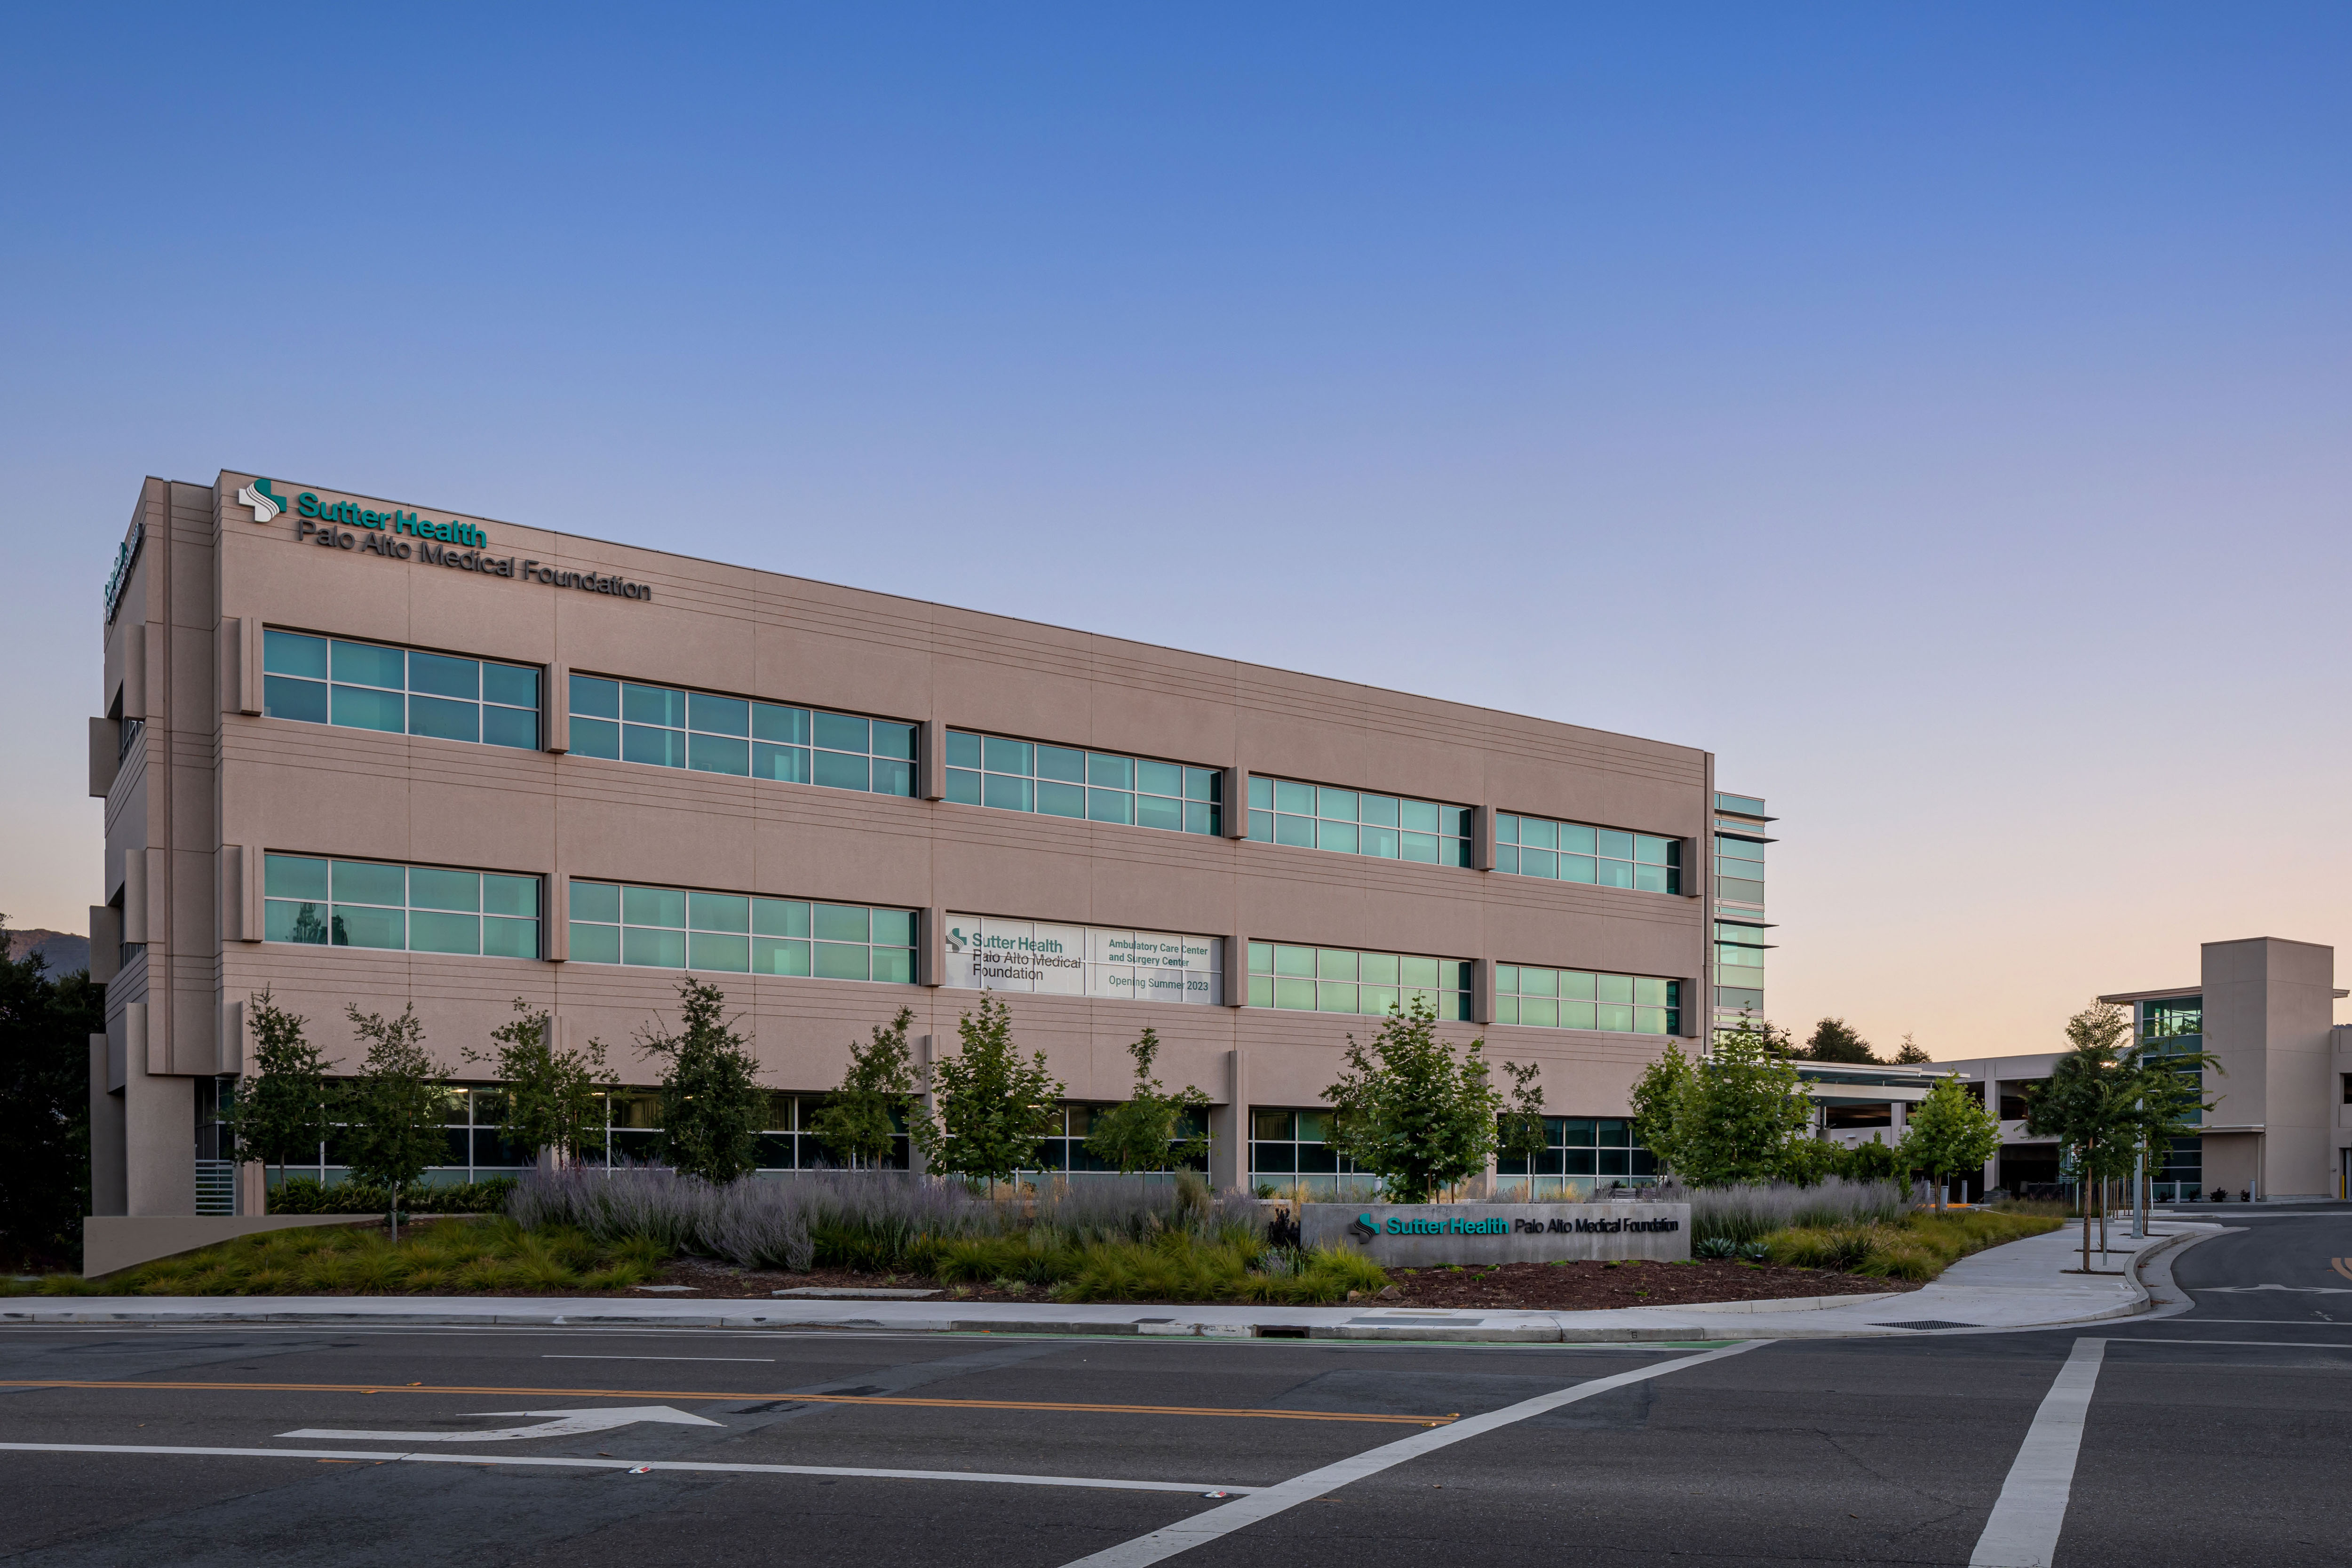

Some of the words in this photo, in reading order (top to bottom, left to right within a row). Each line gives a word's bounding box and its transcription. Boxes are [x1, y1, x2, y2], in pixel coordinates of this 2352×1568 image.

[298, 492, 391, 530] Sutter
[396, 509, 487, 548] Health
[299, 518, 356, 549] Palo
[362, 531, 412, 559] Alto
[421, 541, 515, 578] Medical
[524, 559, 652, 601] Foundation
[972, 933, 1016, 949] Sutter
[1018, 937, 1063, 953] Health
[1109, 939, 1157, 953] Ambulatory
[1160, 944, 1179, 953] Care
[1182, 945, 1208, 955] Center
[973, 948, 1000, 963] Palo
[1004, 951, 1029, 965] Alto
[1033, 954, 1081, 969] Medical
[1109, 953, 1124, 962] and
[1127, 954, 1160, 966] Surgery
[1162, 956, 1189, 967] Center
[973, 963, 1043, 980] Foundation
[1109, 975, 1145, 988] Opening
[1148, 978, 1185, 990] Summer
[1187, 981, 1208, 991] 2023
[1387, 1217, 1447, 1234] Sutter
[1450, 1218, 1509, 1234] Health
[1515, 1218, 1544, 1233] Palo
[1547, 1218, 1572, 1233] Alto
[1576, 1218, 1621, 1233] Medical
[1623, 1218, 1679, 1232] Foundation
